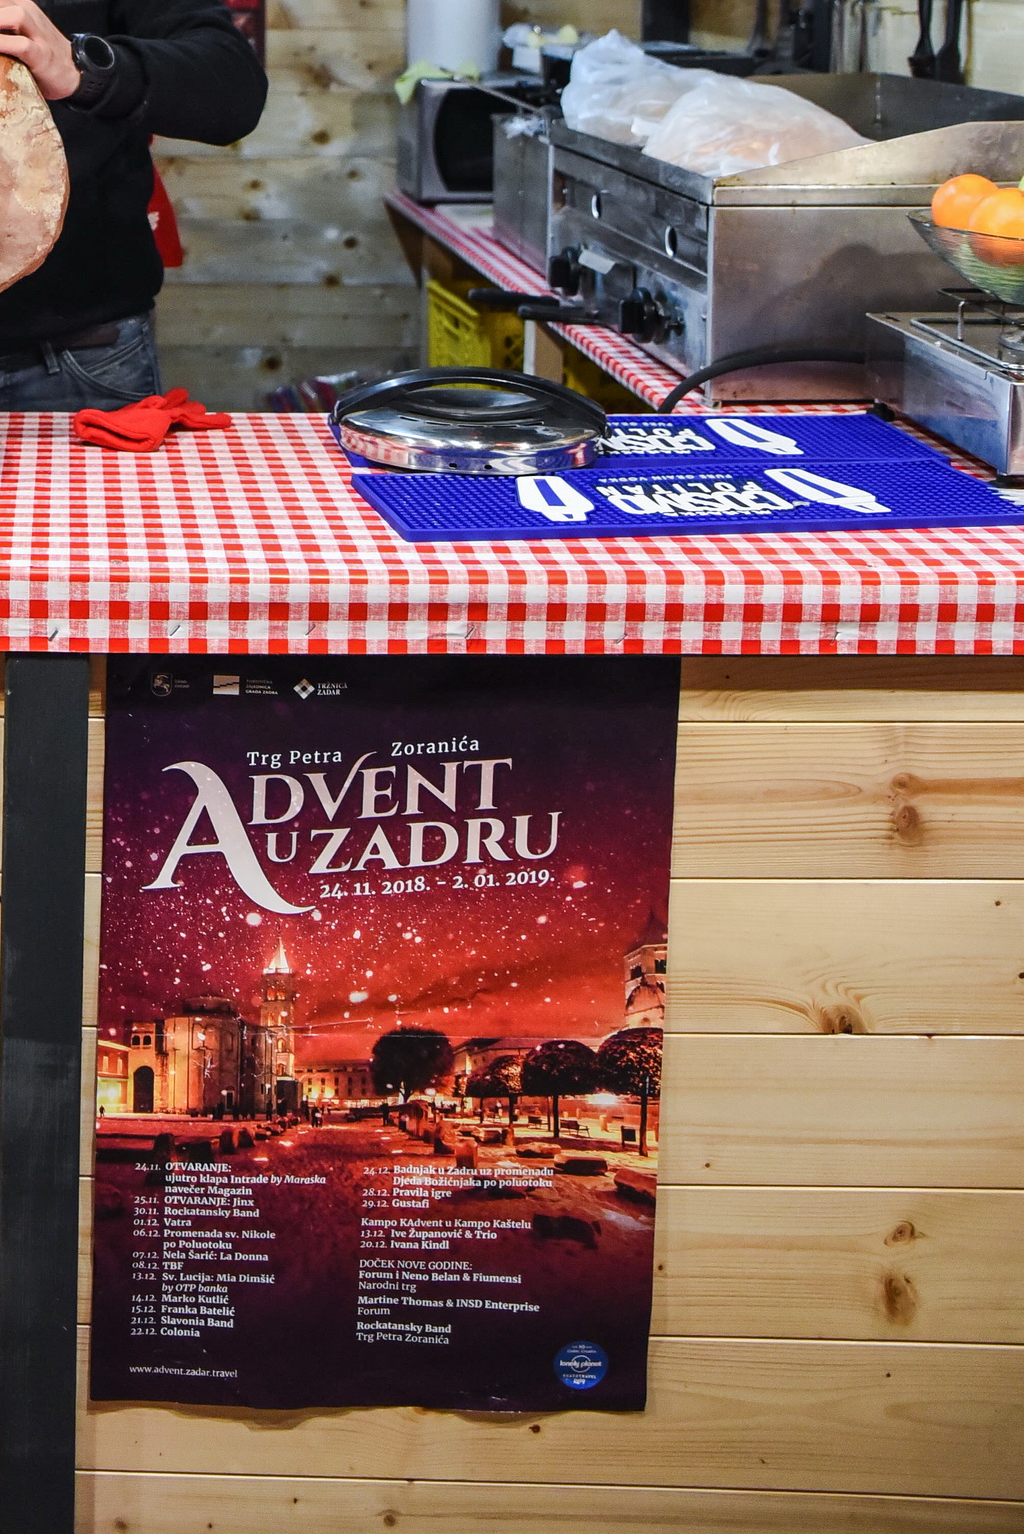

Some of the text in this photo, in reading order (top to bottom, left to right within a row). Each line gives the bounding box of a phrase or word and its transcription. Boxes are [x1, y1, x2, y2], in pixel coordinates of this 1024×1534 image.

[246, 736, 480, 768] Trg Petra Zoranića
[141, 750, 512, 915] ADVENT
[265, 812, 563, 875] U ZADRU
[321, 883, 349, 900] 24.
[354, 882, 375, 897] 11.
[381, 876, 431, 895] 2018.
[452, 875, 469, 890] 2.
[474, 873, 497, 888] 01.
[506, 871, 555, 888] 2019.
[165, 1162, 232, 1173] OTVARANJE:
[393, 1164, 436, 1178] Badnjak
[446, 1166, 478, 1176] Zadru
[479, 1167, 492, 1176] uz
[494, 1166, 554, 1177] promenadu
[165, 1174, 326, 1186] ujutro klapa Intrade by Maraska
[392, 1176, 423, 1186] Djeda
[483, 1178, 497, 1189] po
[498, 1177, 552, 1188] poluotoku
[164, 1184, 252, 1196] navečer Magazin
[392, 1187, 429, 1198] Pravila
[430, 1188, 452, 1200] igre
[164, 1196, 231, 1206] OTVARANJE:
[232, 1197, 254, 1208] Jinx
[392, 1198, 430, 1209] Gustafi
[164, 1207, 231, 1218] Rockatansky
[233, 1208, 260, 1217] Band
[163, 1217, 192, 1227] Vatra
[360, 1218, 398, 1228] Kampo
[400, 1218, 443, 1228] KAdvent
[454, 1218, 490, 1230] Kampo
[492, 1218, 532, 1230] Kaštelu
[163, 1229, 223, 1238] Promenada
[225, 1231, 239, 1239] sv.
[242, 1230, 276, 1239] Nikole
[390, 1229, 406, 1238] Ive
[408, 1227, 462, 1240] Županović
[474, 1230, 498, 1240] Trio
[163, 1240, 232, 1250] po Poluotoku
[390, 1240, 419, 1250] Ivana
[421, 1240, 450, 1250] Kindl
[163, 1251, 186, 1260] Nela
[219, 1252, 232, 1261] La
[234, 1252, 269, 1261] Donna
[162, 1262, 184, 1270] TBF
[359, 1258, 473, 1272] DOČEK NOVE GODINE:
[162, 1273, 177, 1281] Sv.
[179, 1273, 214, 1284] Lucija:
[216, 1273, 236, 1282] Mia
[238, 1273, 275, 1284] Dimšić
[358, 1270, 394, 1280] Forum
[401, 1271, 429, 1282] Neno
[431, 1272, 460, 1282] Belan
[472, 1272, 522, 1284] Fiumensi
[161, 1284, 228, 1294] by OTP banka
[358, 1281, 417, 1294] Narodni trg
[161, 1294, 195, 1303] Marko
[197, 1294, 229, 1305] Kutlić
[358, 1295, 399, 1306] Martine
[400, 1296, 444, 1308] Thomas
[456, 1298, 482, 1309] INSD
[484, 1299, 540, 1314] Enterprise
[161, 1305, 197, 1314] Franka
[199, 1305, 235, 1316] Batelić
[357, 1306, 390, 1316] Forum
[160, 1316, 205, 1326] Slavonia
[207, 1317, 234, 1328] Band
[356, 1321, 452, 1334] Rockatansky Band
[160, 1327, 200, 1337] Colonia
[356, 1332, 450, 1345] Trg Petra Zoranića
[129, 1365, 238, 1378] www.advent.zadar.travel
